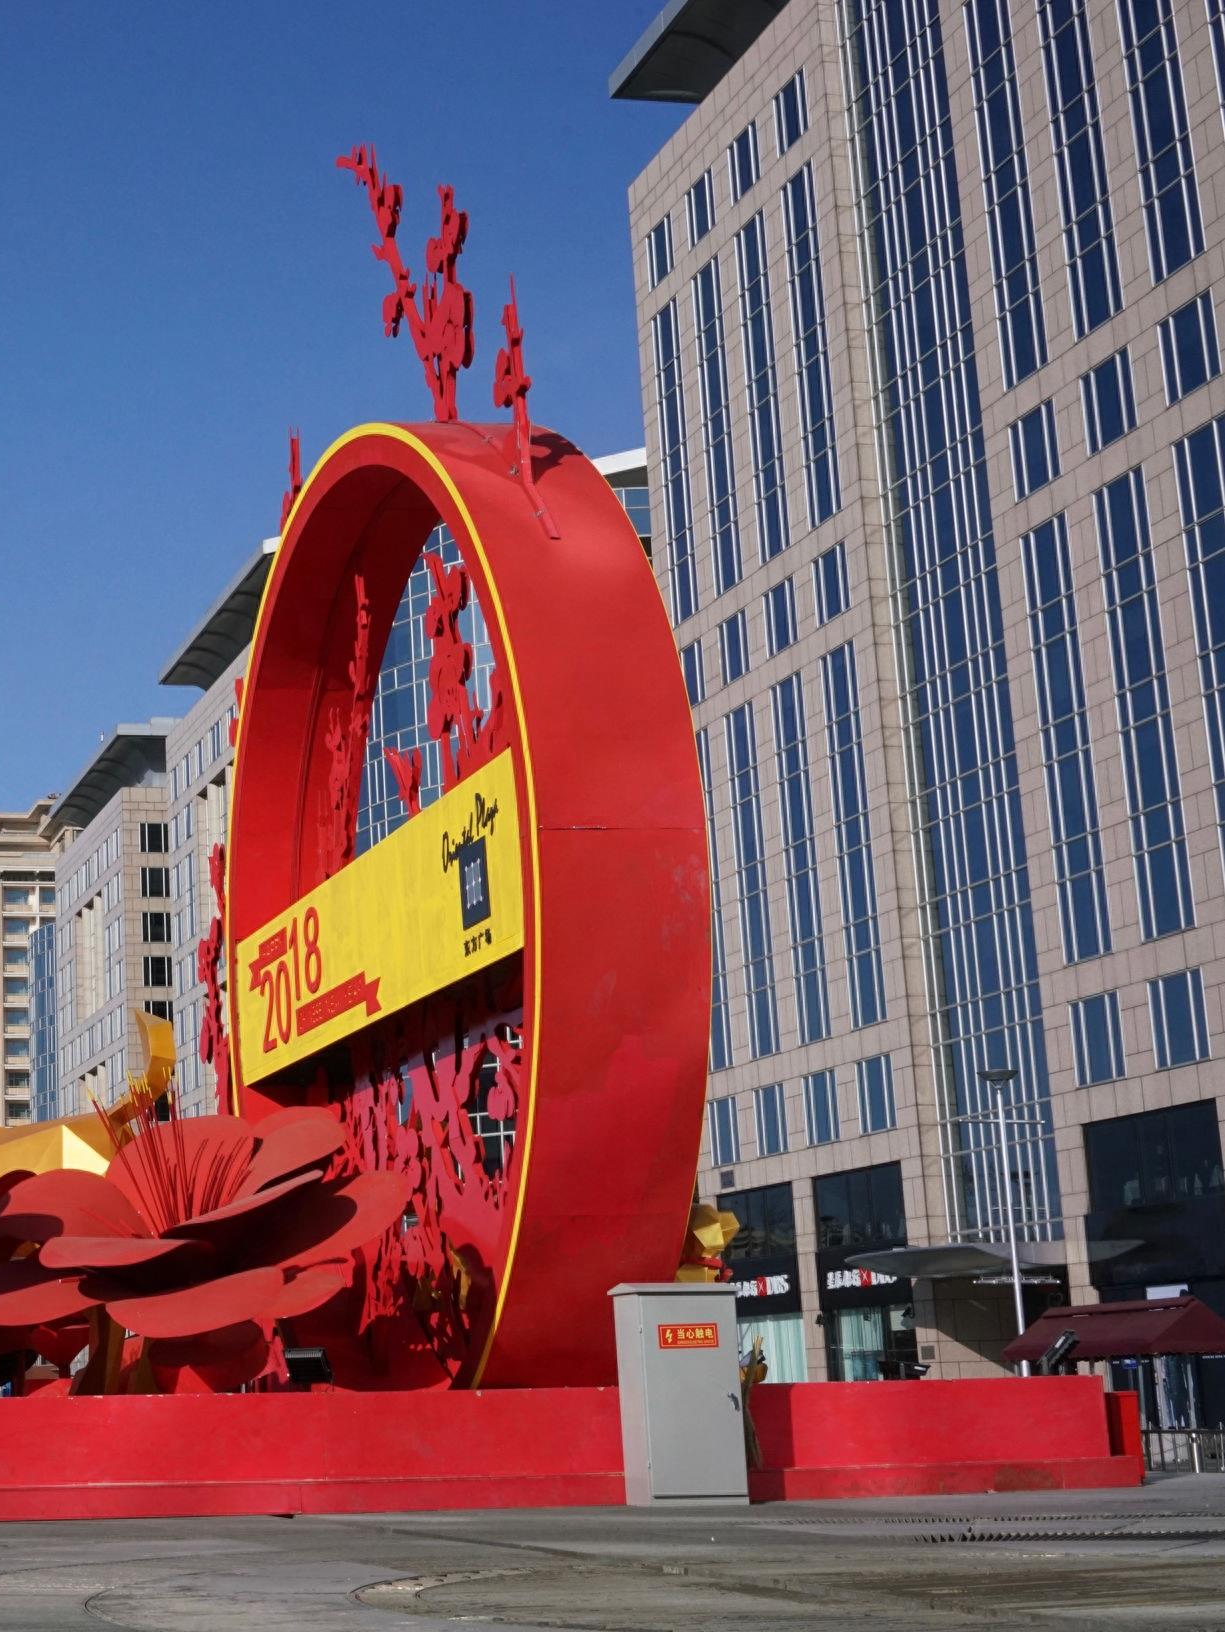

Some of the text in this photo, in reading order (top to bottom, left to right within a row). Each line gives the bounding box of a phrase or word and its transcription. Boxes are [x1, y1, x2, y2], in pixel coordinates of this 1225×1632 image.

[260, 906, 322, 1053] 2018
[677, 1328, 714, 1339] 当心触电
